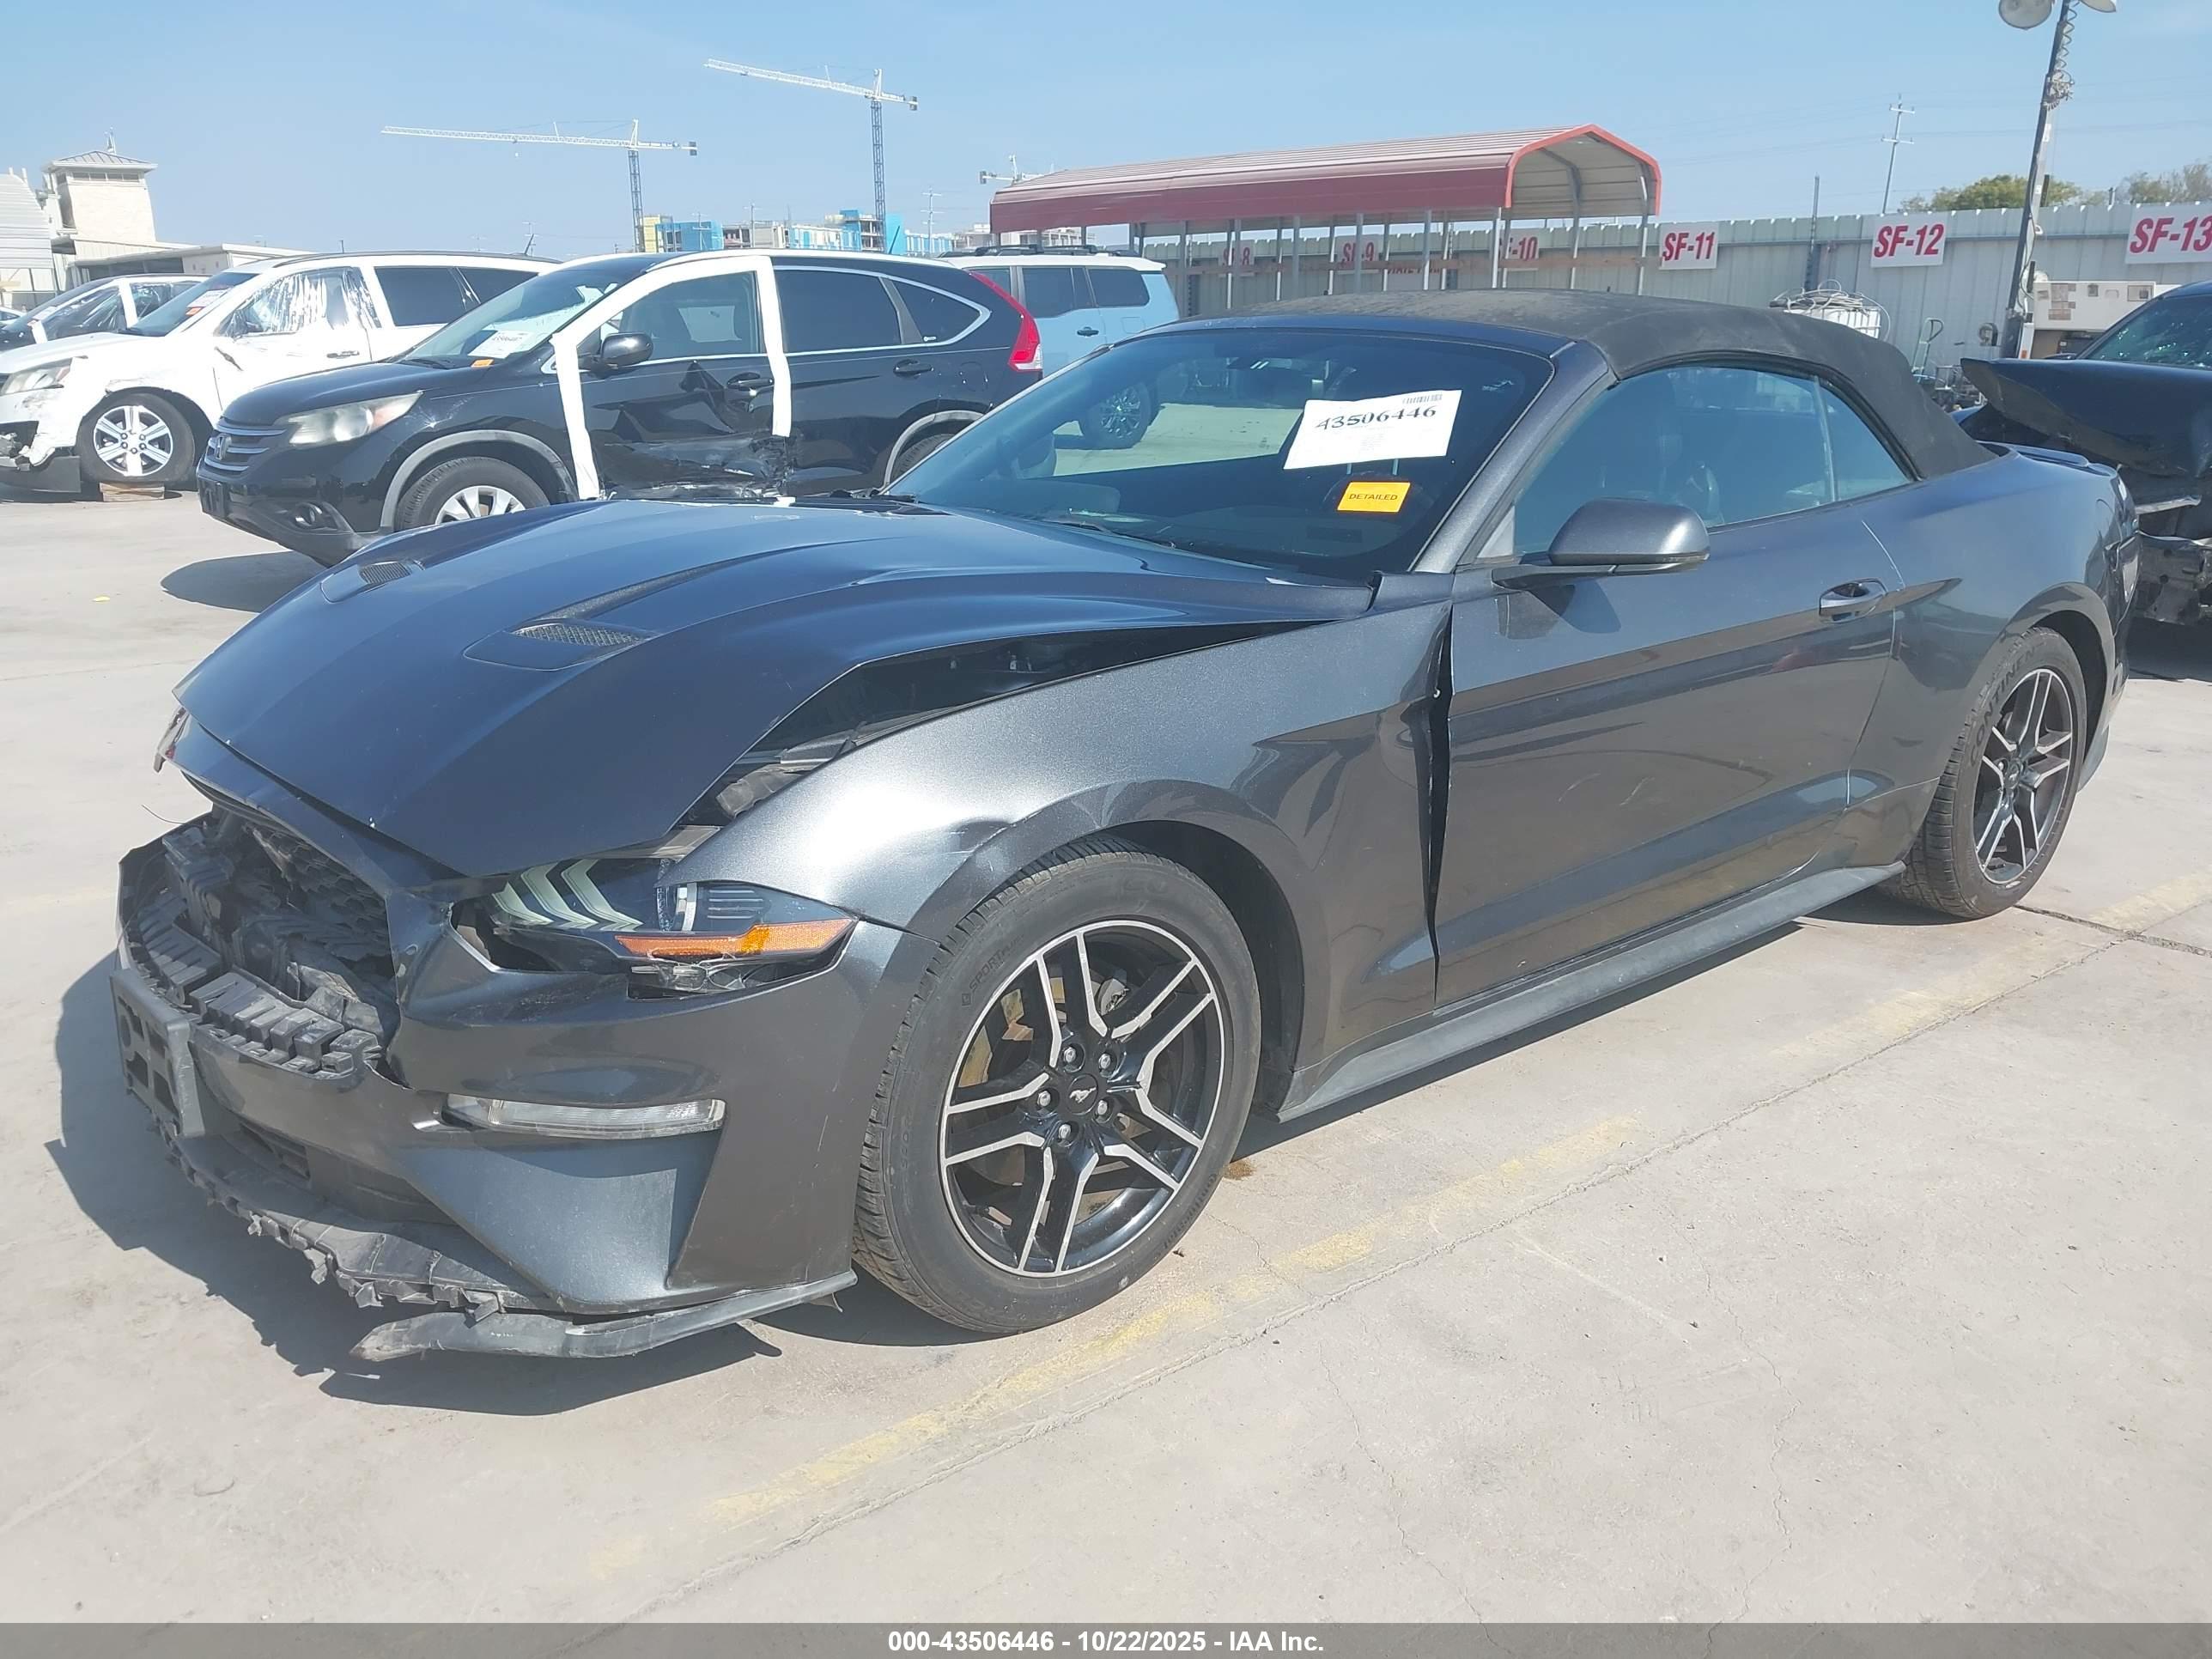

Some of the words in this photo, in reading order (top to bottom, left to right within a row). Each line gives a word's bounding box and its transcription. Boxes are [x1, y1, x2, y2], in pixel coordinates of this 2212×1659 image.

[1662, 231, 1715, 261] SF-11
[1874, 223, 1944, 258] SF-12
[2130, 215, 2212, 253] SF-13
[1316, 405, 1437, 430] 43506446
